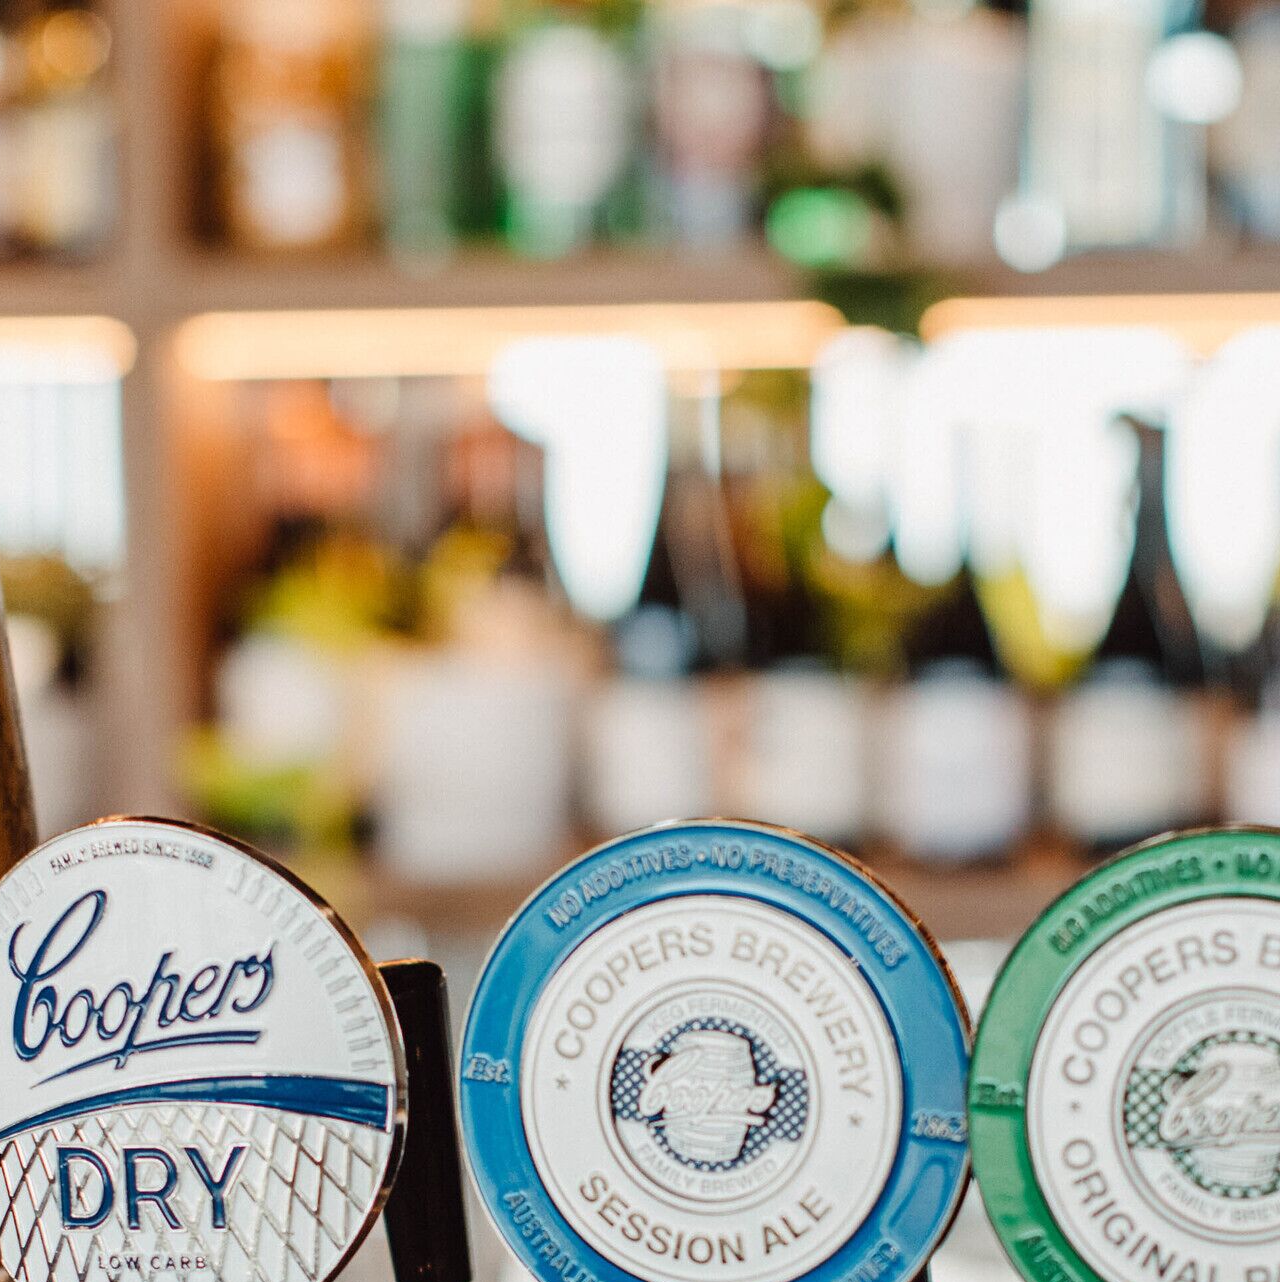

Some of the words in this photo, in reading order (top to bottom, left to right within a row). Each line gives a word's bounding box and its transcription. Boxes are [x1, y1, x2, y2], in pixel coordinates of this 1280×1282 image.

[50, 849, 87, 875] FAMILY
[91, 841, 139, 859] BREWED
[143, 841, 180, 859] SINCE
[546, 890, 582, 928] NO
[582, 843, 693, 903] ADDITIVES
[710, 844, 745, 870] NO
[749, 849, 909, 967] PRESERVATIVES
[9, 889, 278, 1068] Coopers
[555, 922, 716, 1062] COOPERS
[730, 928, 875, 1100] BREWERY
[1061, 931, 1239, 1087] COOPERS
[56, 1145, 247, 1231] DRY
[579, 1169, 745, 1265] SESSION
[762, 1187, 833, 1255] ALE
[98, 1255, 141, 1270] LOW
[150, 1255, 208, 1270] CARB
